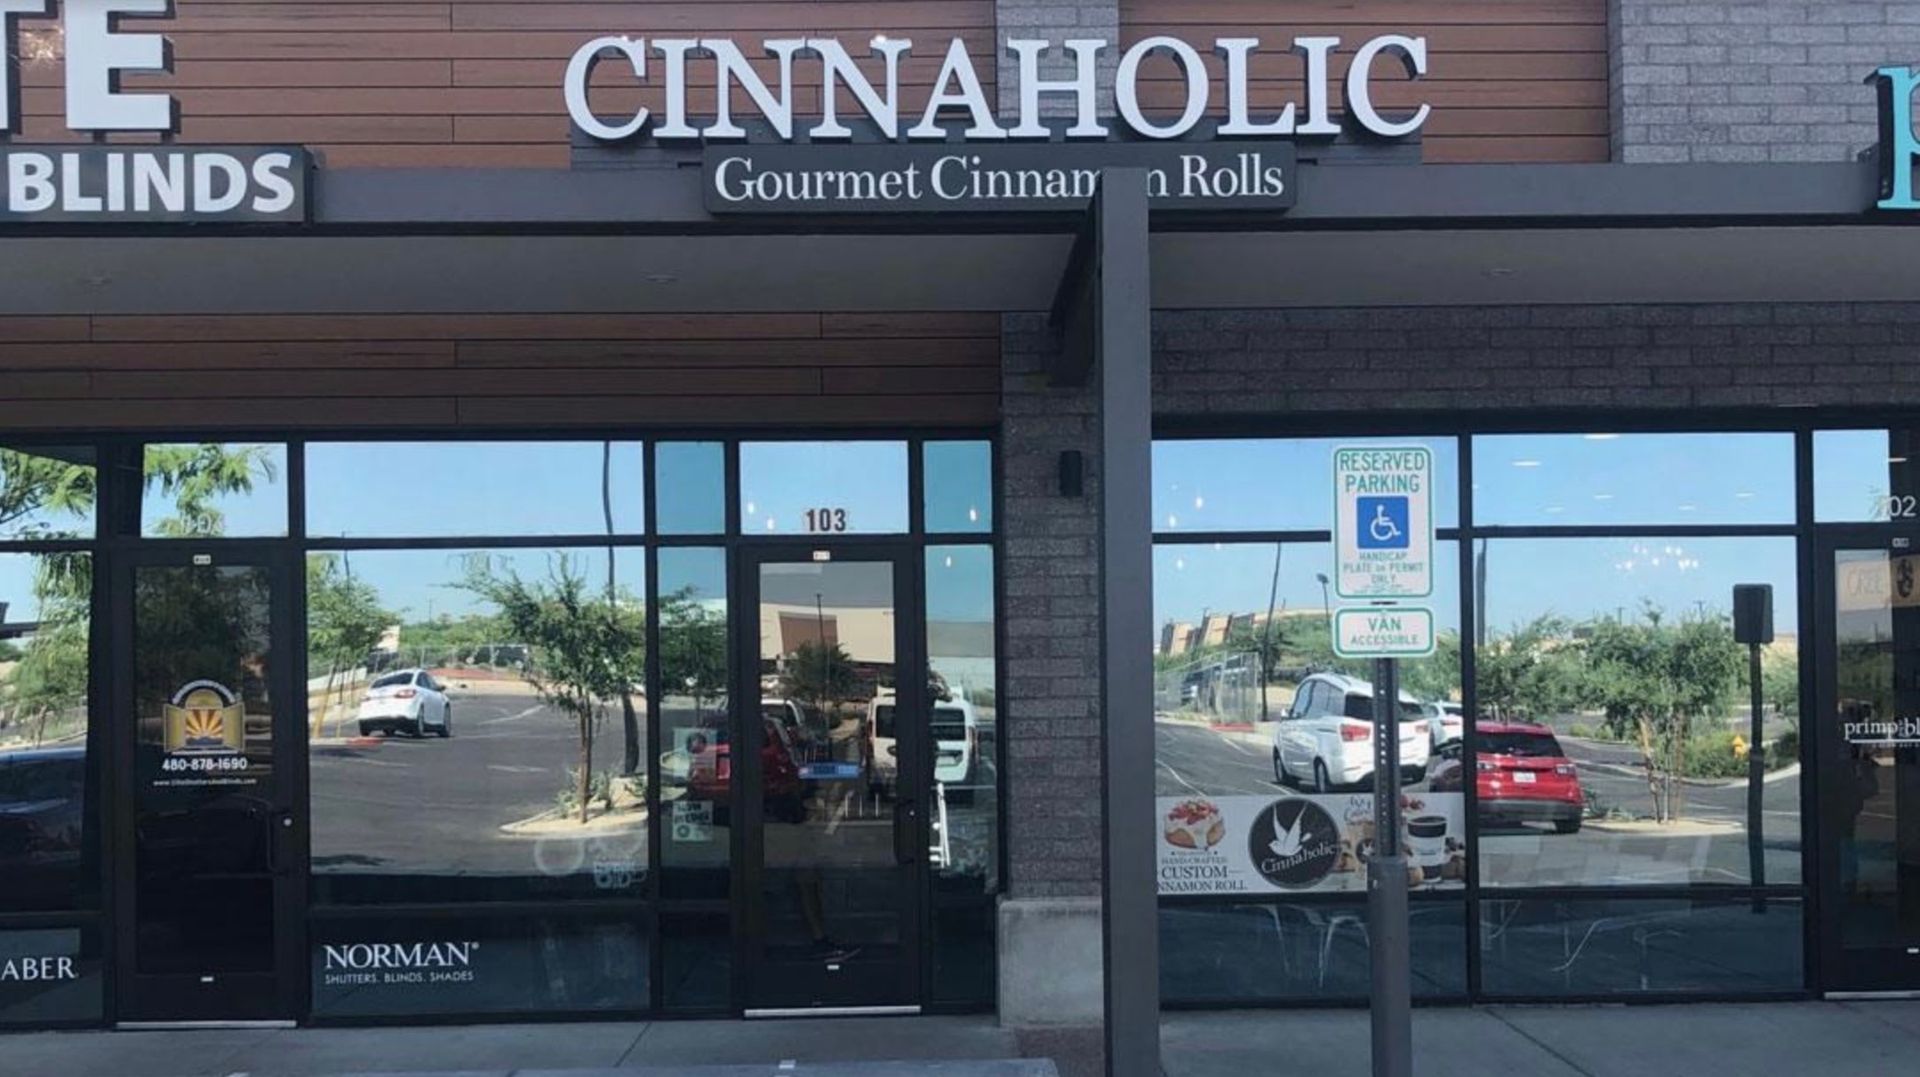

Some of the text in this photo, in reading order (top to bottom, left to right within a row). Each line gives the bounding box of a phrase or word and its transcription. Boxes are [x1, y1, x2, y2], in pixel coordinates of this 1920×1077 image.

[564, 35, 1430, 139] CINNAHOLIC
[8, 153, 295, 213] BLINDS
[715, 154, 1284, 201] Gourmet Cinnamn Rolls
[1340, 453, 1424, 471] RESERVED
[1345, 474, 1419, 493] PARKING
[806, 508, 846, 532] 103
[1360, 551, 1407, 561] HANDICAP
[1343, 562, 1371, 573] PLATE
[1390, 562, 1423, 572] PERMIT
[1371, 574, 1396, 584] ONLY
[1368, 616, 1402, 632] VAN
[1350, 634, 1418, 646] ACCESSIBLE
[1844, 717, 1898, 740] primp
[162, 758, 247, 771] 480-878-1690
[1261, 840, 1337, 874] Cinnaholic
[1161, 866, 1228, 880] CUSTOM
[1214, 880, 1248, 891] ROLL
[430, 971, 474, 982] SHADES
